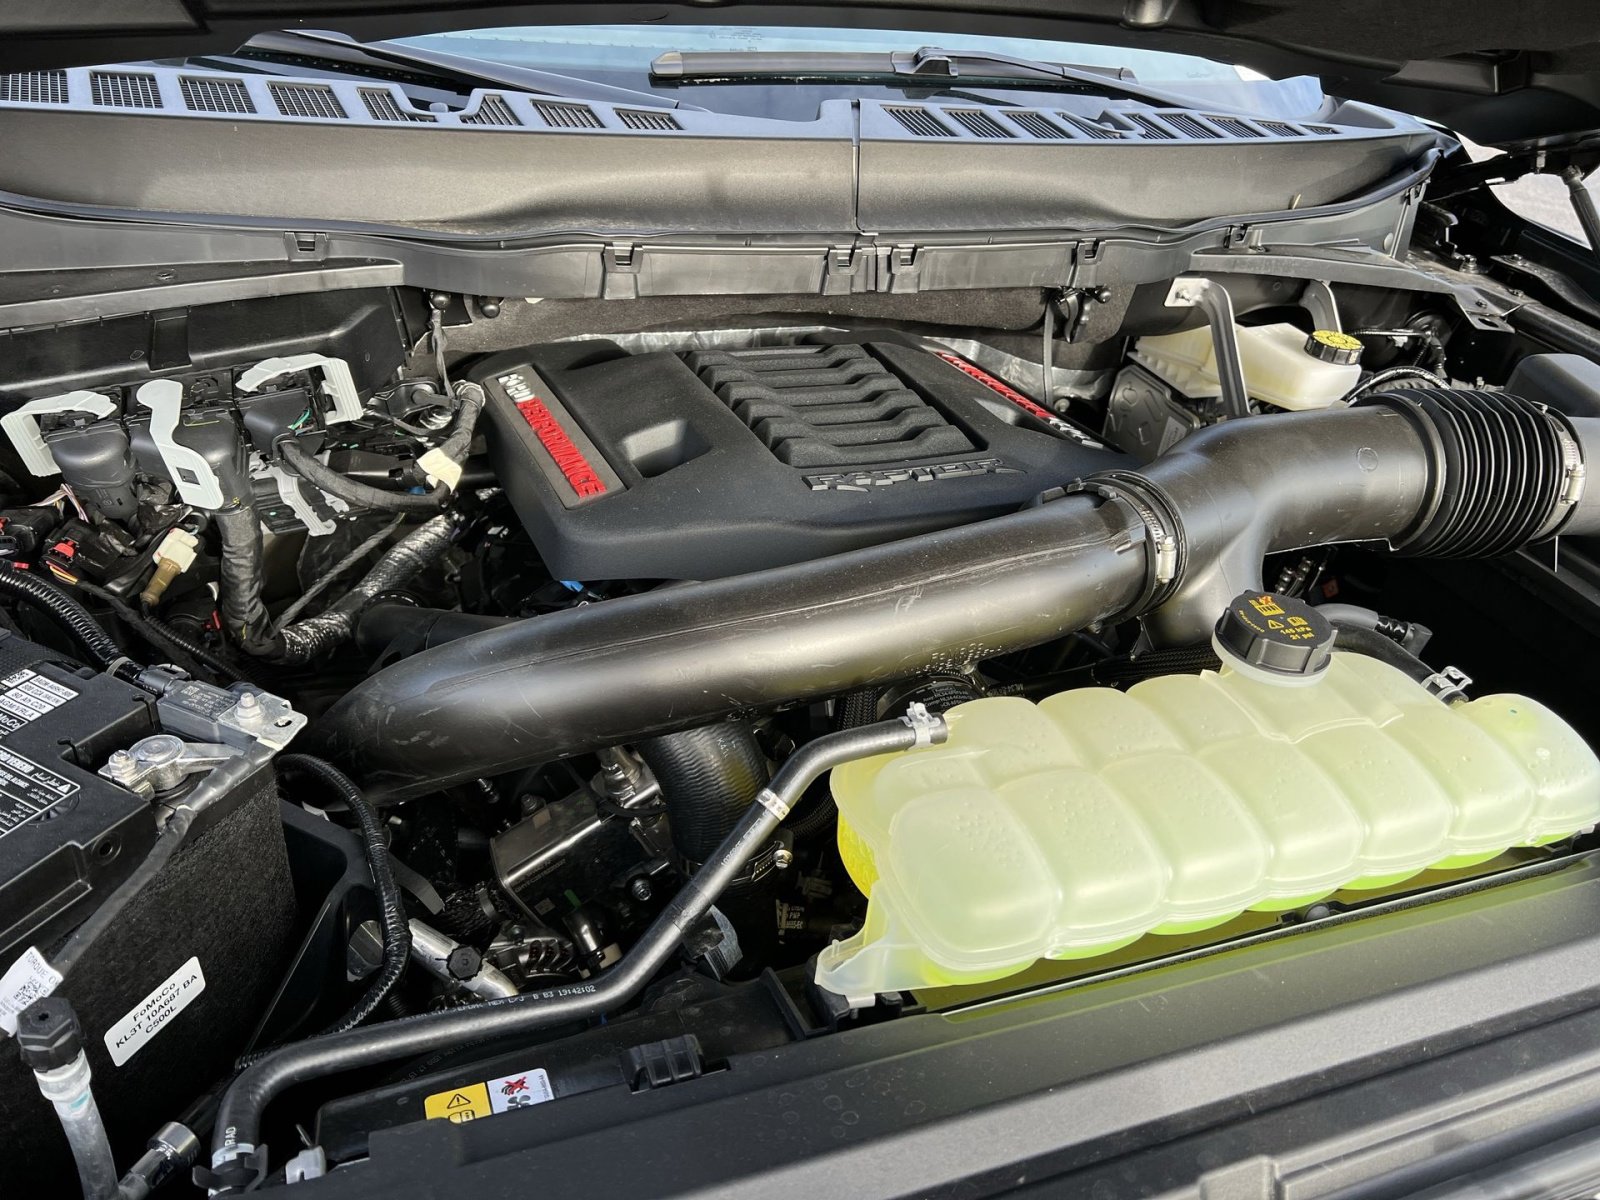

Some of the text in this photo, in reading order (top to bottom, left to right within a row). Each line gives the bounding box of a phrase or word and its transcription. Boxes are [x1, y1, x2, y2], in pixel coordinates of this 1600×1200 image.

[516, 397, 608, 498] PERFORMANCE
[801, 458, 1027, 492] RAPTOR
[132, 983, 176, 1022] FoMoCo
[558, 984, 596, 997] 19:42:02
[115, 974, 198, 1048] KL3T 10A687 BA
[145, 1005, 177, 1034] C500L
[224, 1126, 236, 1147] RAD
